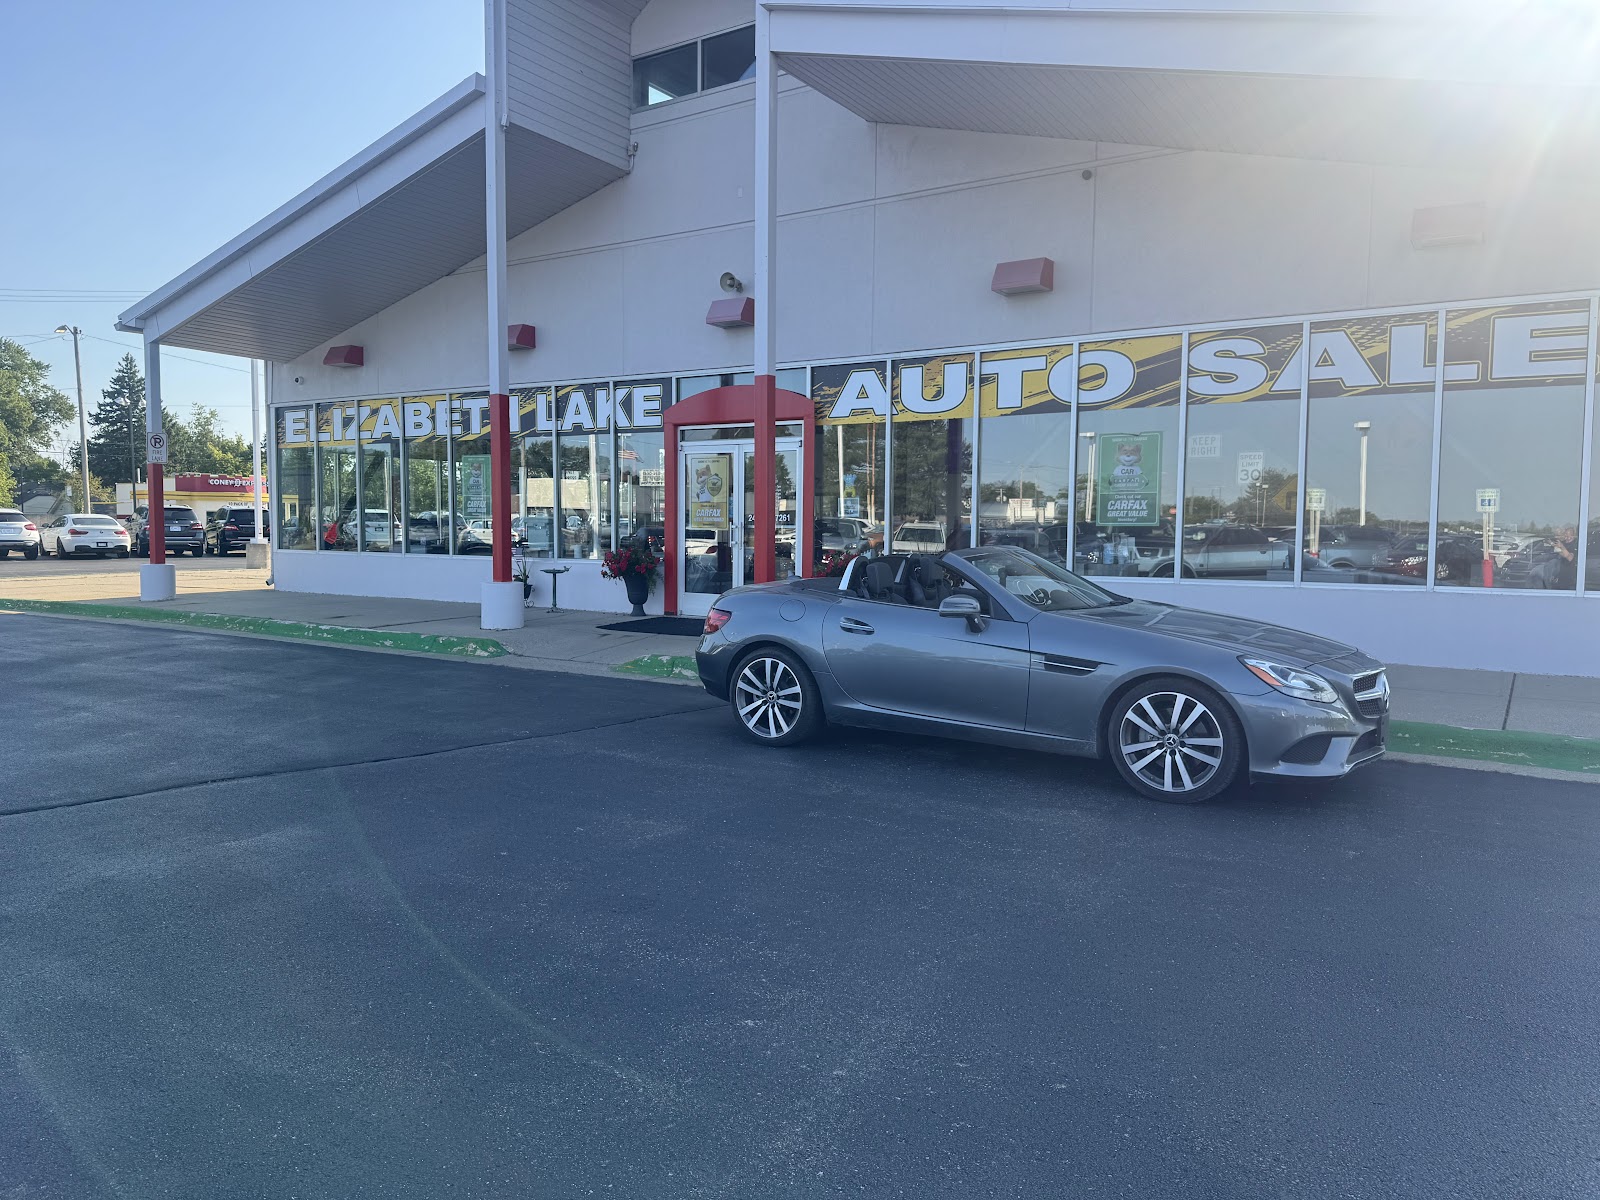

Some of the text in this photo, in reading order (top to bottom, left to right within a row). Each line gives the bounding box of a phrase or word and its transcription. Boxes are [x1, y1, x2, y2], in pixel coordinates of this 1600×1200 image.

[535, 383, 664, 432] LAKE
[828, 349, 1137, 418] AUTO
[1186, 308, 1600, 397] SALE
[1192, 436, 1217, 446] KEEP
[1191, 446, 1217, 456] RIGHT
[1240, 469, 1261, 481] 30
[467, 500, 486, 508] CARFAX
[1107, 500, 1148, 510] CARFAX
[696, 509, 721, 517] CARFAX
